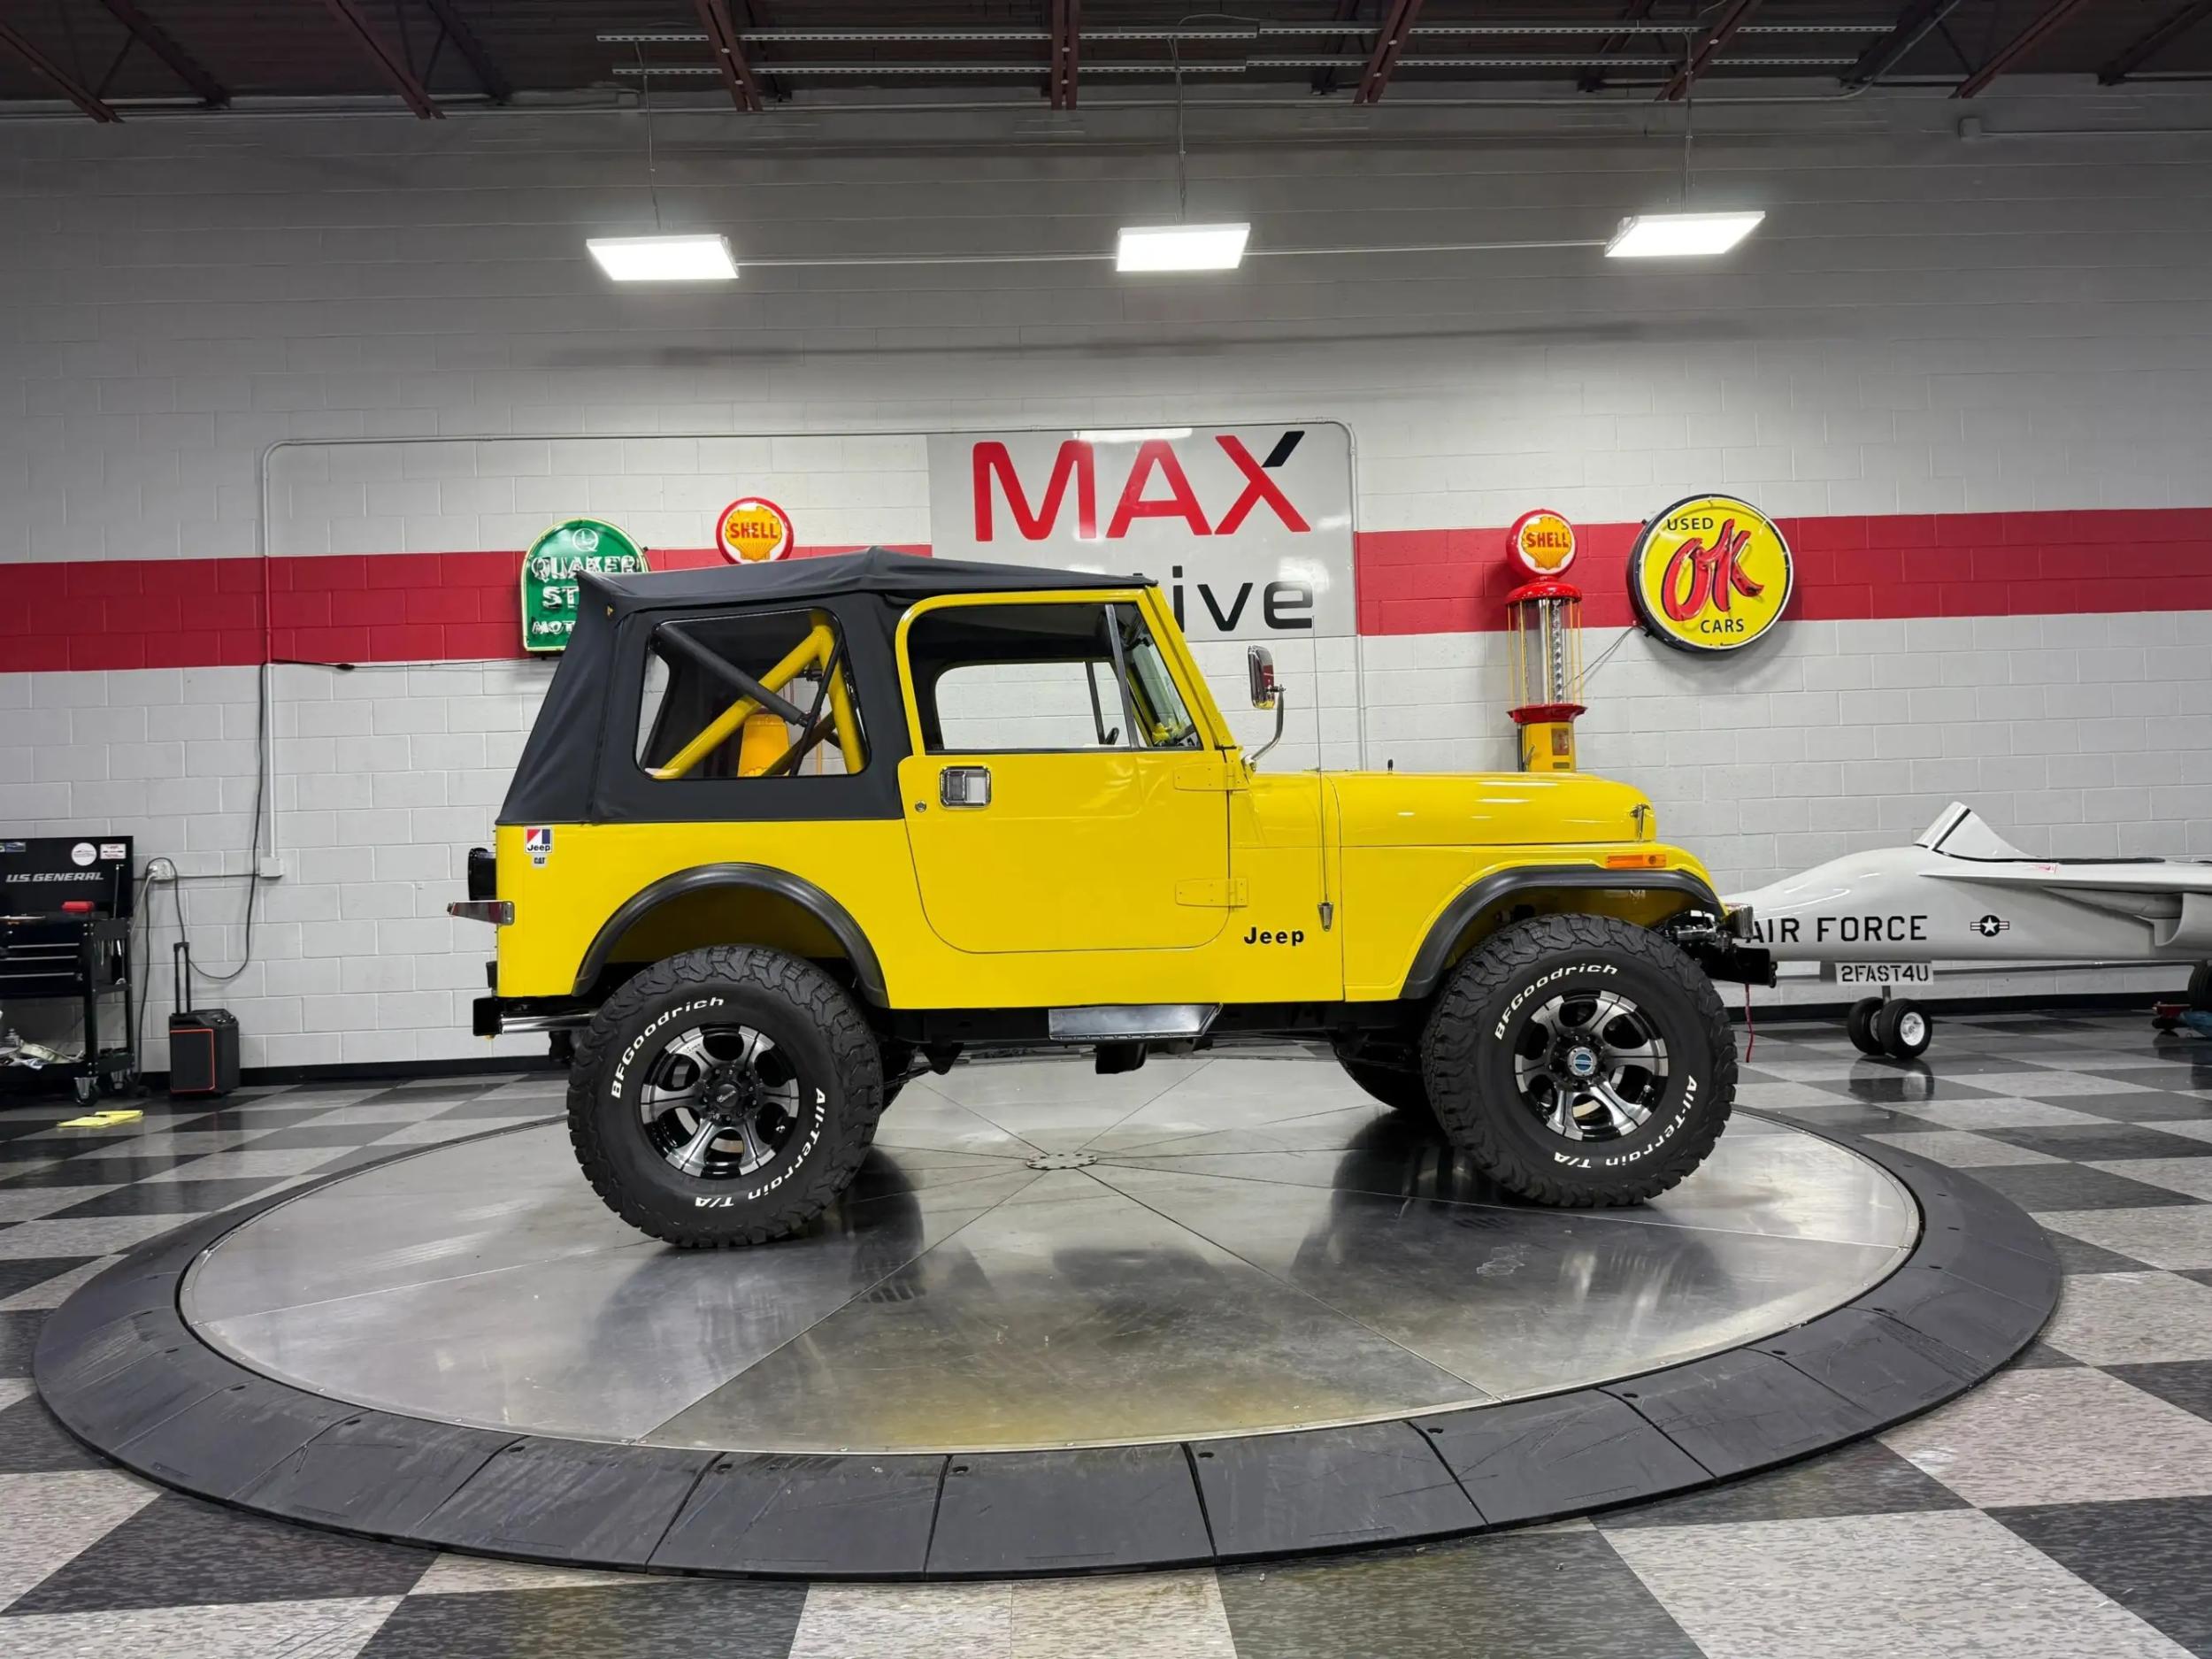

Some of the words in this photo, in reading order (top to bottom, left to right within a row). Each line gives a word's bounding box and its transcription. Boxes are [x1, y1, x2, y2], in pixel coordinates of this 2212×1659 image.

[973, 431, 1311, 541] MAX
[729, 522, 778, 539] SHELL
[1667, 518, 1715, 532] USED
[1525, 530, 1569, 548] SHELL
[531, 556, 638, 582] QUAKER
[1663, 518, 1764, 622] OK
[1170, 565, 1314, 634] ive
[1701, 618, 1745, 634] CARS
[32, 872, 104, 882] GENERAL
[1243, 926, 1305, 947] Jeep
[1816, 915, 1928, 942] FORCE
[1840, 964, 1930, 983] 2FAST4U
[1494, 963, 1619, 1041] BFGoodrich
[611, 996, 726, 1099] BFGoodrich
[1605, 1074, 1700, 1167] All-Terrain
[747, 1087, 827, 1202] All-Terrain
[1553, 1151, 1592, 1170] T/A
[695, 1195, 735, 1209] T/A
